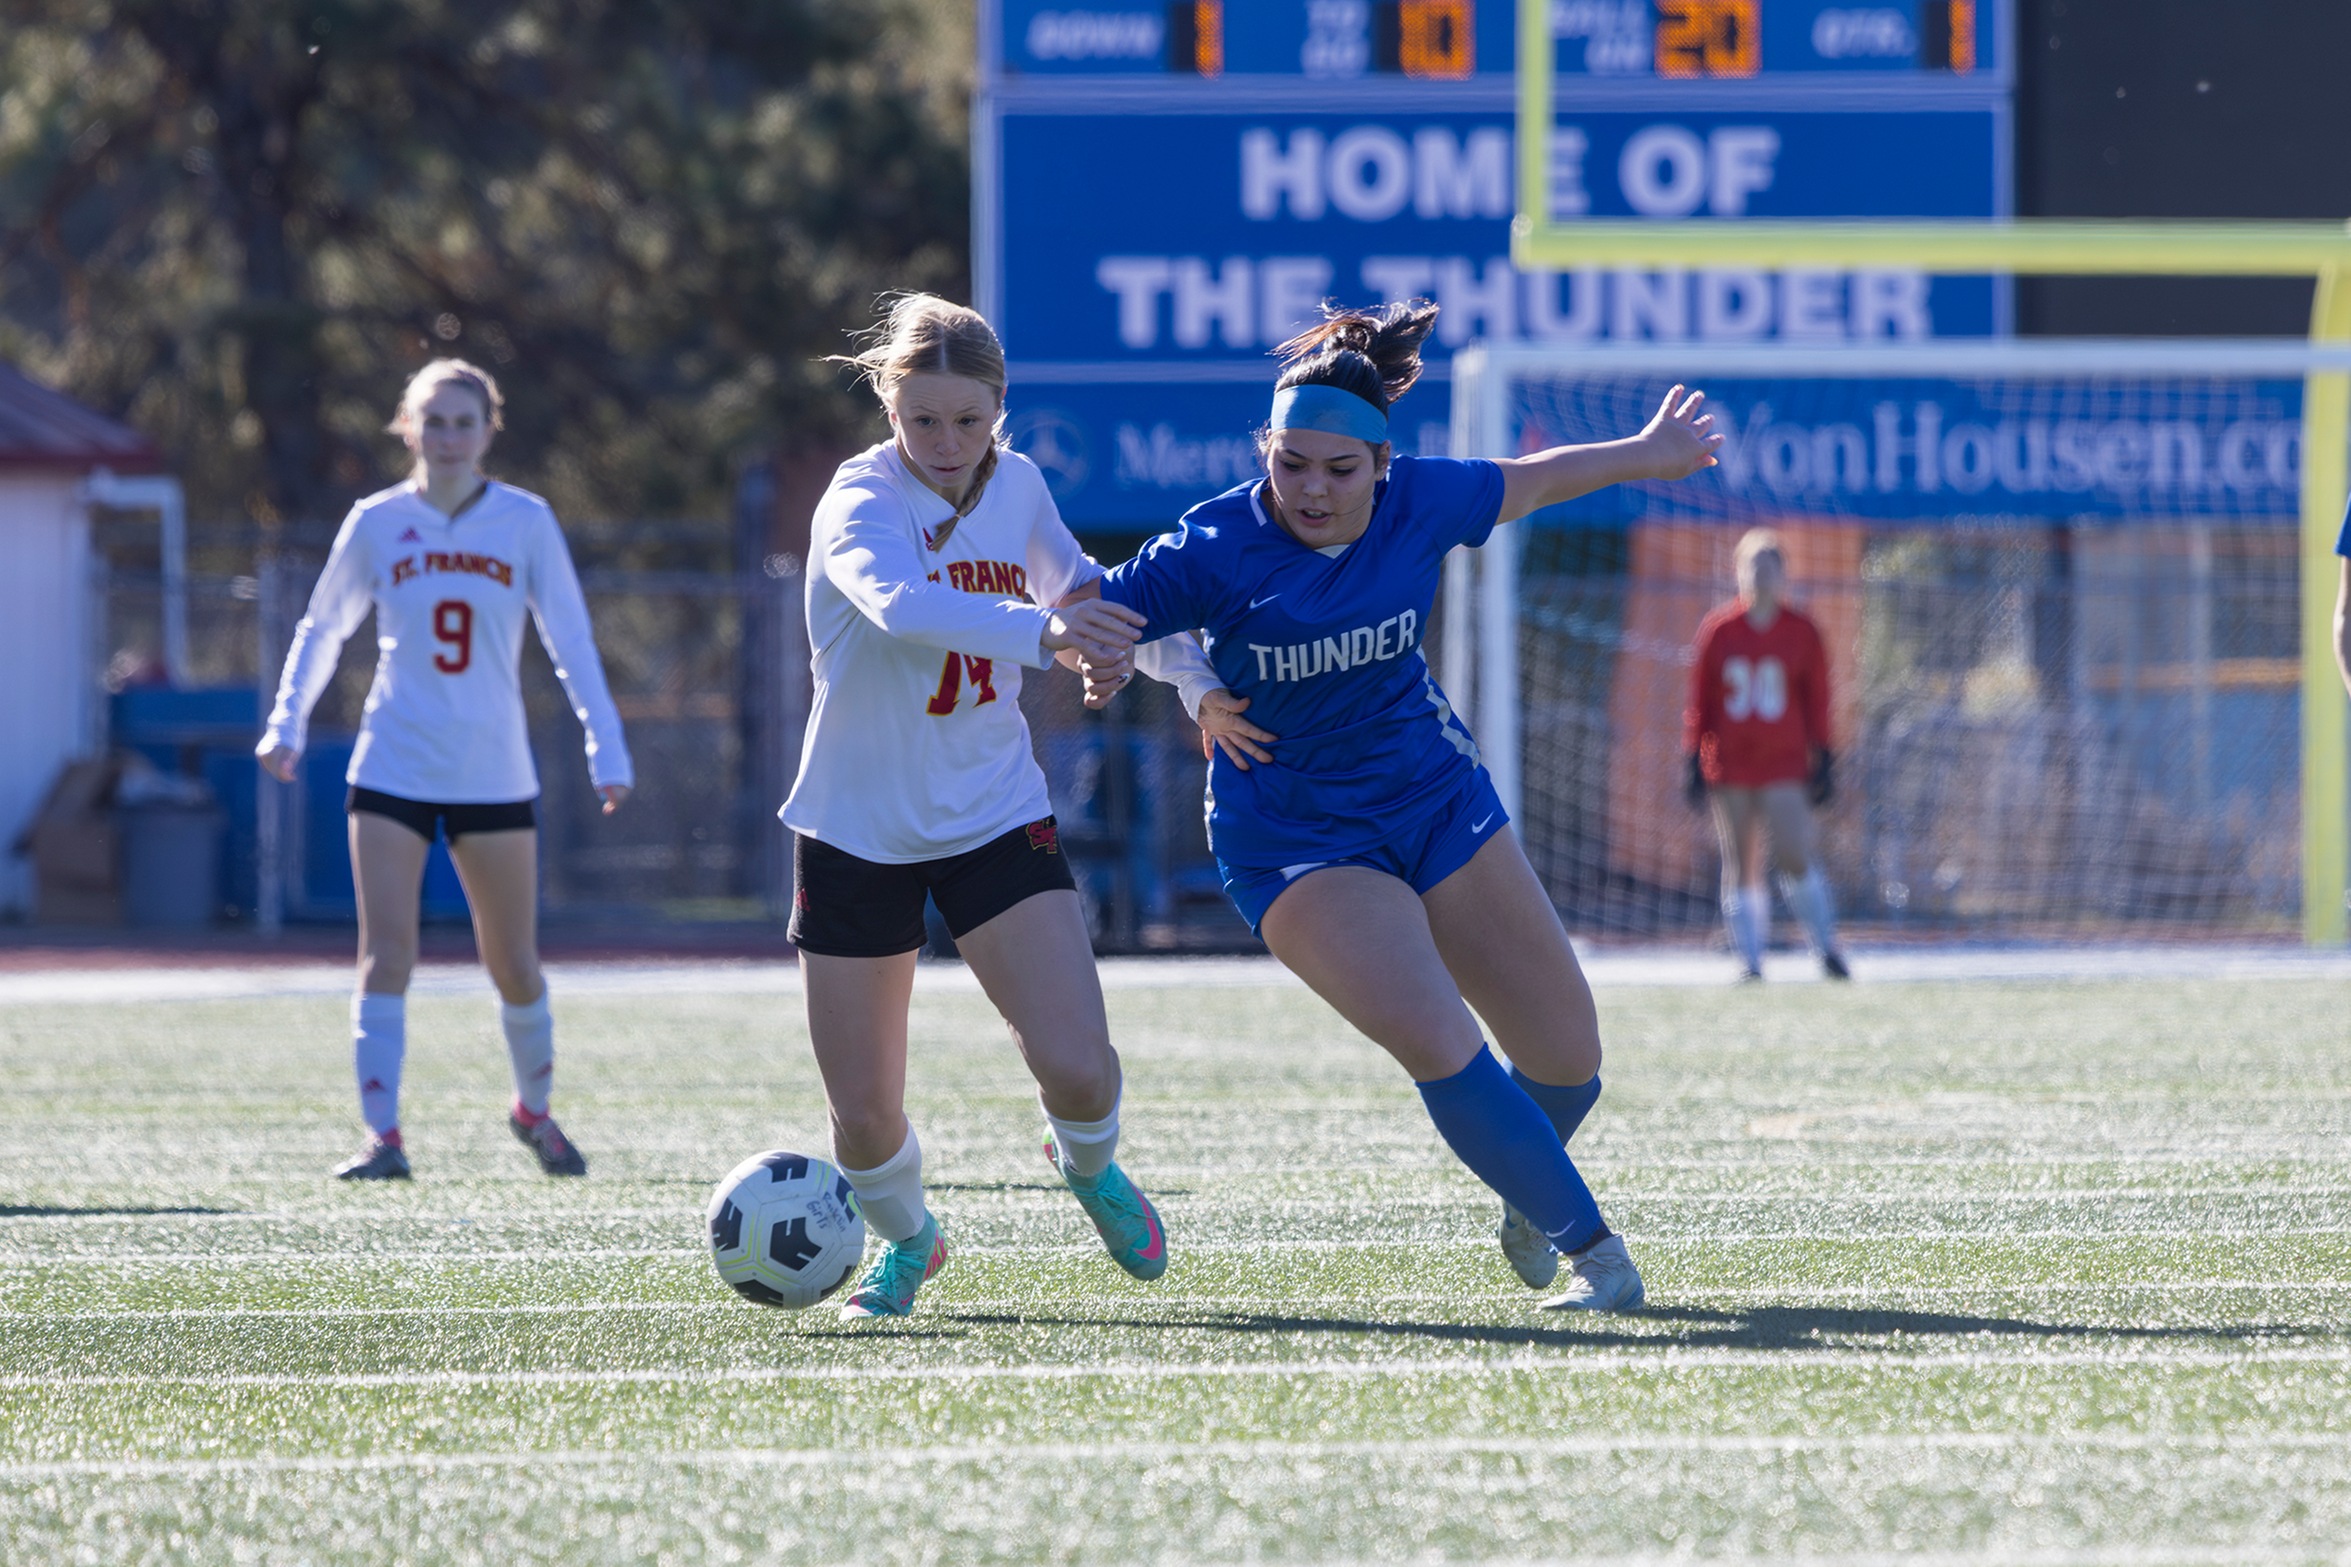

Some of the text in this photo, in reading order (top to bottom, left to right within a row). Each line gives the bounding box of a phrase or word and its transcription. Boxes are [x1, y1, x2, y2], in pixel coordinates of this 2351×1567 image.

[1654, 0, 1761, 79] 20
[1240, 123, 1782, 221] HOME OF
[1097, 256, 1931, 349] THE THUNDER
[1114, 400, 2302, 497] Merc VonHousen.co
[424, 551, 514, 588] FRANCIS
[946, 560, 1027, 600] FRANC
[433, 600, 473, 675] 9
[1248, 608, 1417, 683] THUNDER
[926, 650, 997, 716] 14
[805, 1199, 830, 1231] Girls
